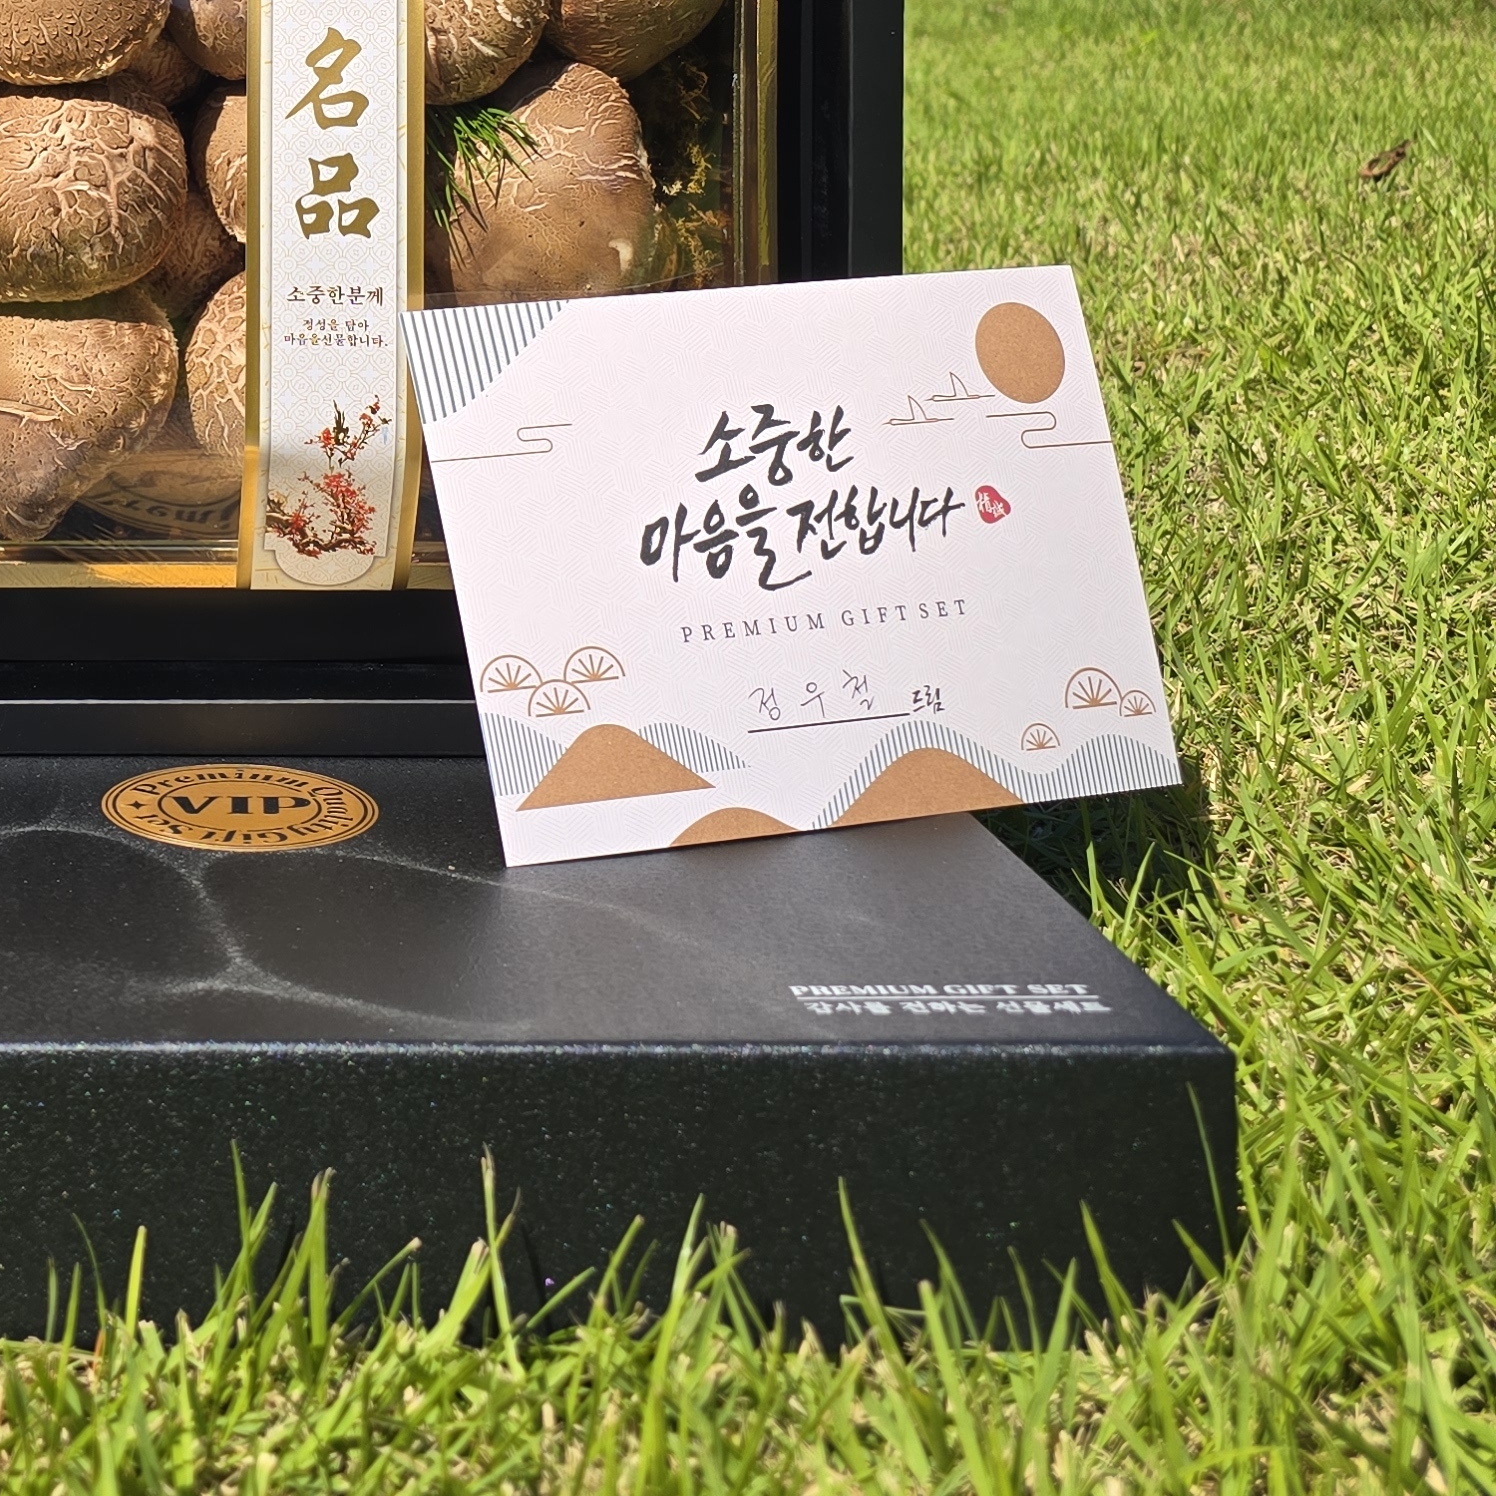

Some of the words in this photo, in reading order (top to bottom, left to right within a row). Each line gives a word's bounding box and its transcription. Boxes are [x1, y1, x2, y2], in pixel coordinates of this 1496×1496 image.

[284, 26, 381, 240] 名品
[286, 284, 385, 307] 소중한분께
[302, 317, 340, 332] 정성을
[345, 318, 370, 332] 담아
[694, 403, 854, 486] 소중한
[639, 483, 813, 591] 마음을
[785, 484, 966, 560] 전합니다
[680, 612, 825, 643] PREMIUM
[840, 604, 908, 627] GIFT
[917, 599, 966, 619] SET
[911, 684, 945, 715] 드림
[167, 795, 311, 815] VIP
[787, 983, 939, 997] PREMIUM
[942, 983, 1019, 996] GIFT
[1026, 983, 1091, 996] SET
